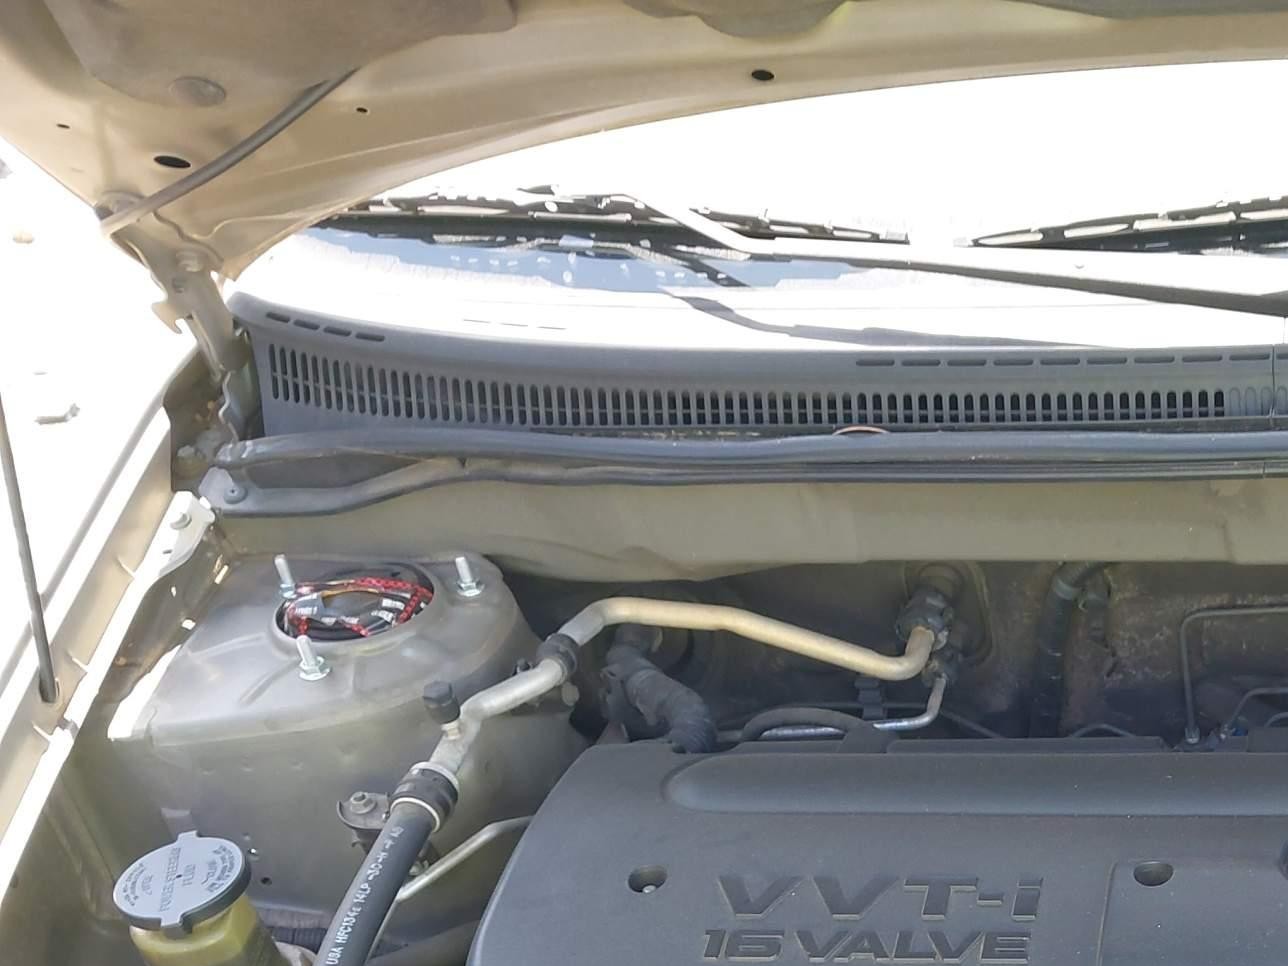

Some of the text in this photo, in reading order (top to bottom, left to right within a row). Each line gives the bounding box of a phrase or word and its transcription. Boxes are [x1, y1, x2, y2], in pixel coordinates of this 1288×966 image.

[325, 946, 345, 965] USA
[702, 929, 1031, 964] 16 VALVE
